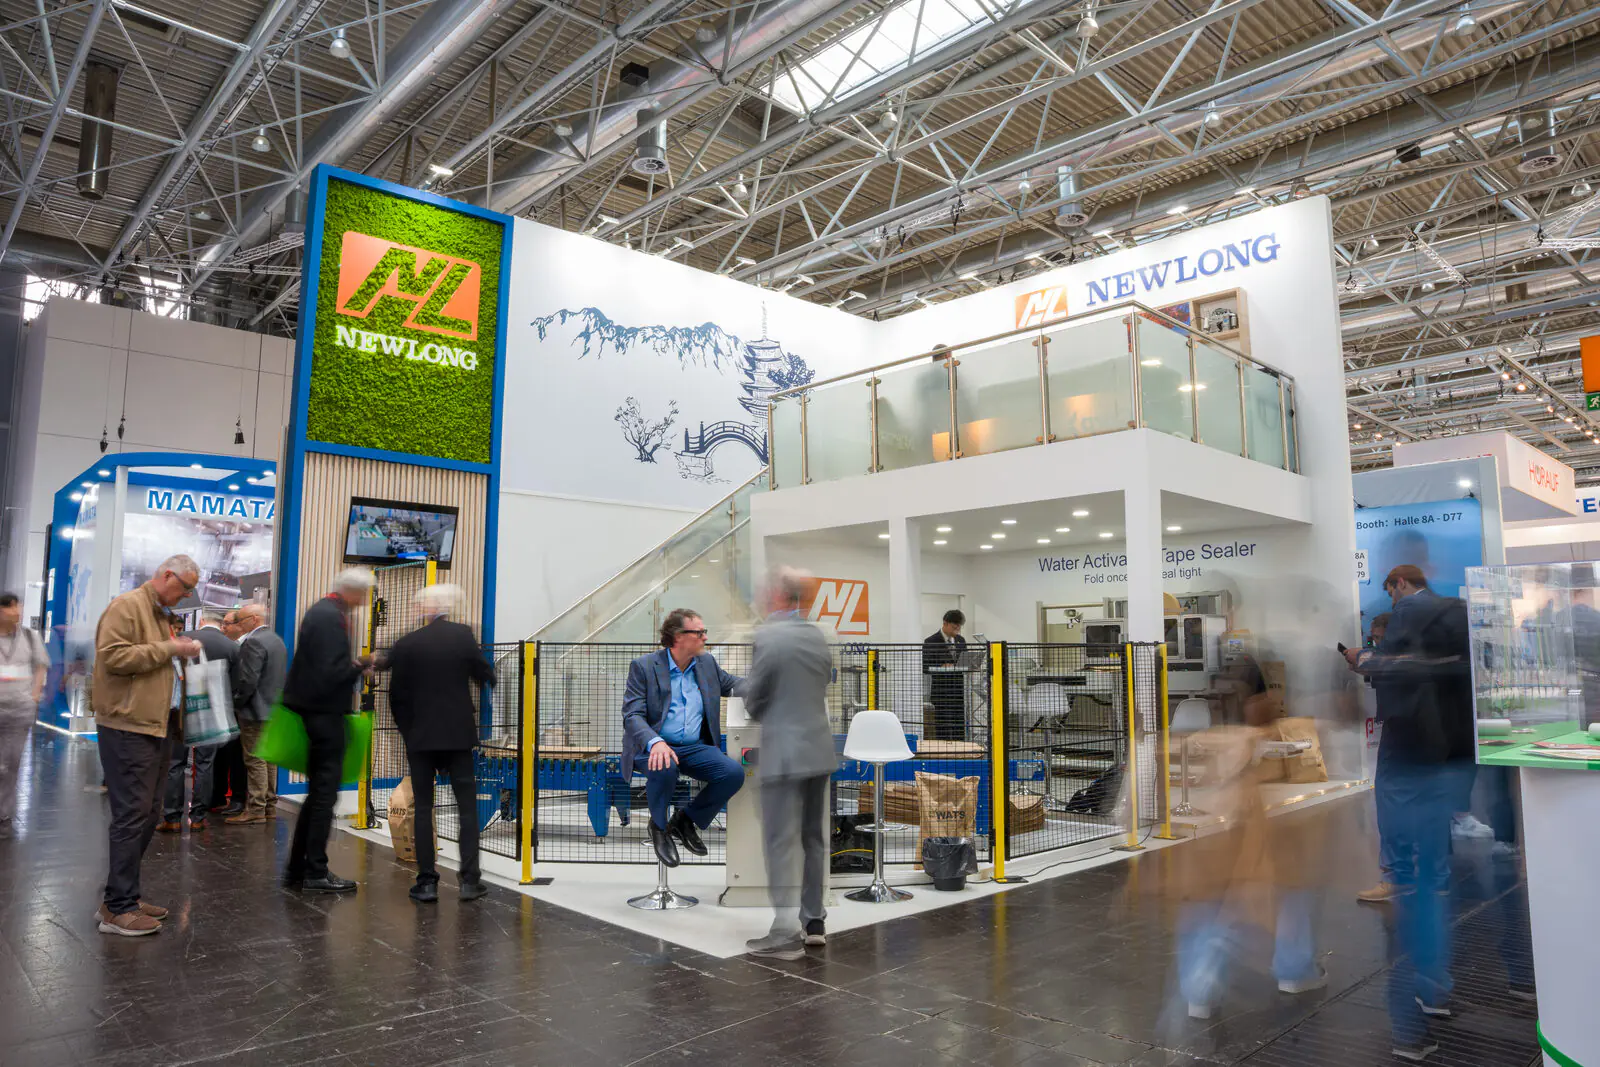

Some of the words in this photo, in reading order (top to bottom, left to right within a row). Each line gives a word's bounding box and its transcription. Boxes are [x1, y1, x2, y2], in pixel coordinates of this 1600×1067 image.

[1086, 232, 1281, 306] NEWLONG
[334, 324, 479, 371] NEWLONG
[1356, 519, 1389, 530] Booth:
[1394, 516, 1420, 526] Halle
[1421, 514, 1435, 524] 8A
[1443, 512, 1463, 522] D77
[1038, 556, 1080, 572] Water
[1082, 552, 1128, 569] Activa
[1161, 547, 1195, 566] Tape
[1201, 541, 1257, 560] Sealer
[1354, 552, 1365, 560] 8A
[1357, 561, 1364, 569] D
[1084, 573, 1104, 584] Fold
[1162, 568, 1177, 579] eal
[1179, 566, 1202, 580] tight
[935, 810, 966, 820] WATS
